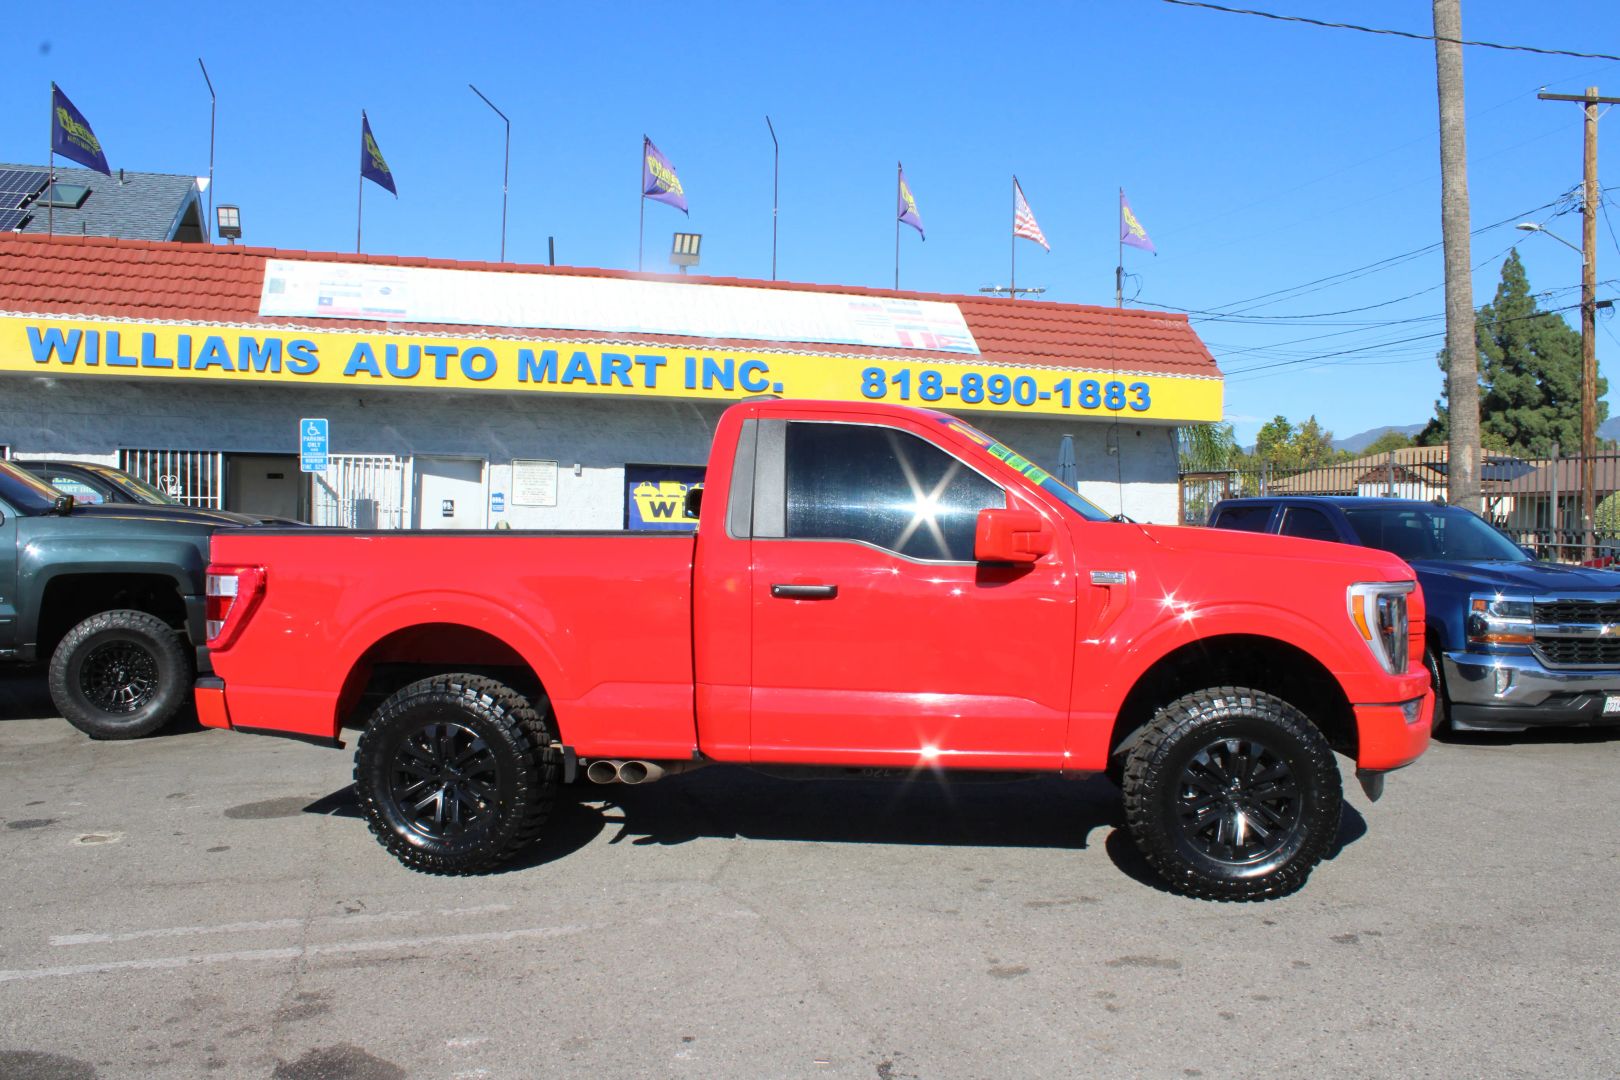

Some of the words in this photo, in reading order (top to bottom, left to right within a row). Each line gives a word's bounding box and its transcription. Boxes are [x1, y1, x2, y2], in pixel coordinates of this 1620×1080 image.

[26, 326, 320, 374] WILLIAMS
[343, 342, 498, 380] AUTO
[518, 349, 667, 388] MART
[684, 356, 784, 392] INC.
[861, 367, 1151, 411] 818-890-1883
